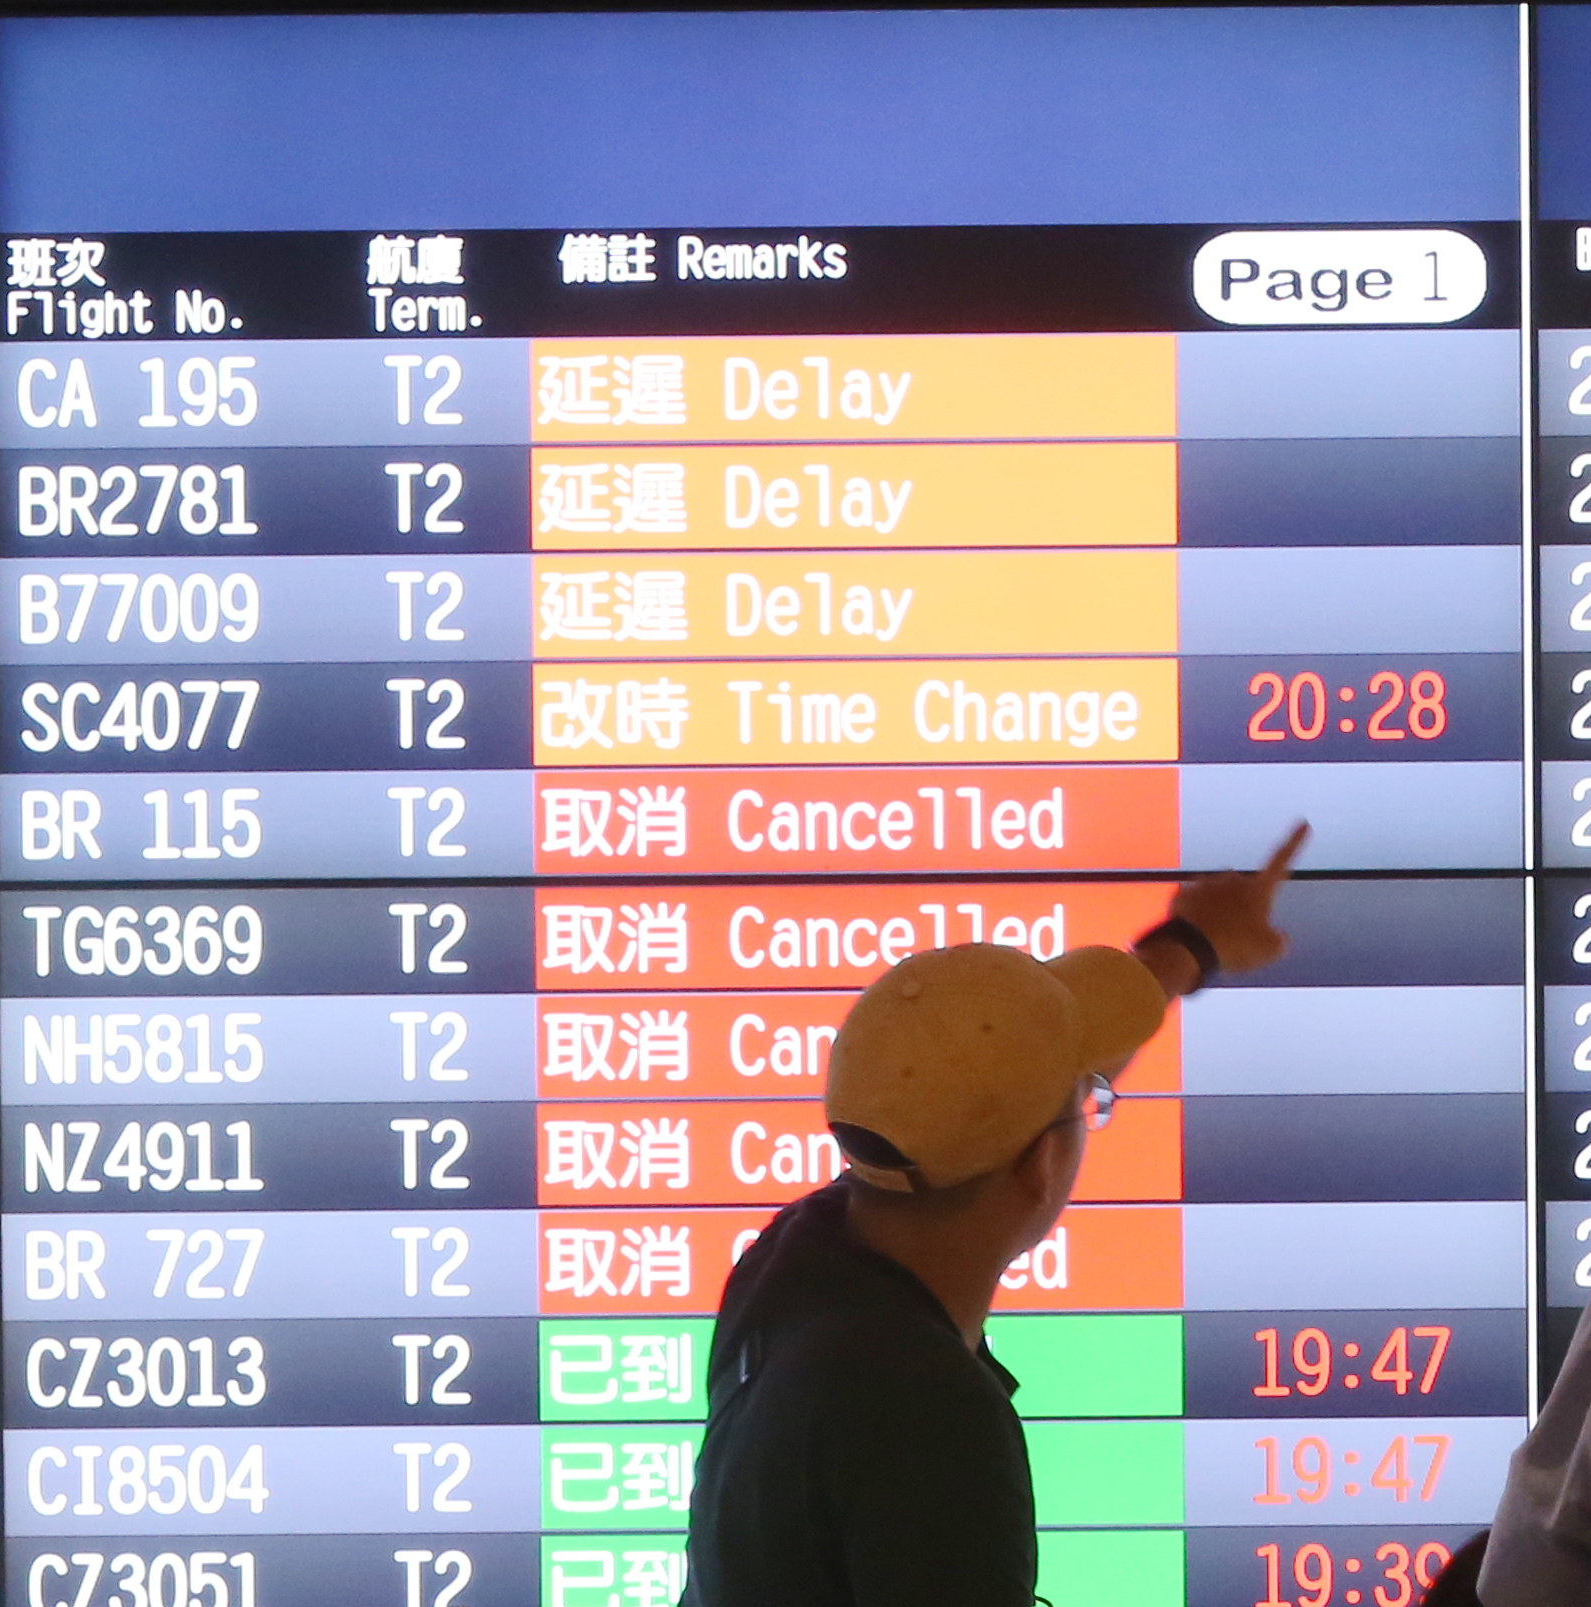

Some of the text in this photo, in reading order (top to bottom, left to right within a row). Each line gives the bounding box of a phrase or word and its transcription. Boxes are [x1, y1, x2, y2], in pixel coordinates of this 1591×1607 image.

[6, 237, 106, 289] 班次
[366, 233, 465, 286] 航廈
[558, 232, 848, 284] 備註 Remarks
[1219, 249, 1449, 313] Page 1
[7, 289, 243, 340] Flight No.
[367, 287, 483, 333] Term.
[17, 354, 259, 429] CA 195
[18, 464, 259, 537] BR2781
[384, 462, 464, 534] T2
[536, 460, 915, 536] 延遲 Delay
[19, 571, 260, 645] B77009
[21, 679, 261, 753] SC4077
[385, 678, 466, 750] T2
[538, 675, 1142, 751] 改時 Time Change
[1245, 669, 1449, 743] 20:28
[539, 783, 1066, 859] 取消 Cancelled
[22, 904, 263, 977] TG6369
[388, 902, 468, 974] T2
[540, 900, 690, 976] 取消
[23, 1011, 265, 1086] NH5815
[24, 1120, 265, 1193] NZ4911
[389, 1118, 470, 1190] T2
[542, 1116, 691, 1191] 取消
[26, 1335, 267, 1408] CZ3013
[391, 1334, 472, 1405] T2
[548, 1331, 694, 1406] 已到
[1250, 1324, 1453, 1399] 19:47
[27, 1443, 271, 1517] CI8504
[1253, 1434, 1450, 1505] 19:47
